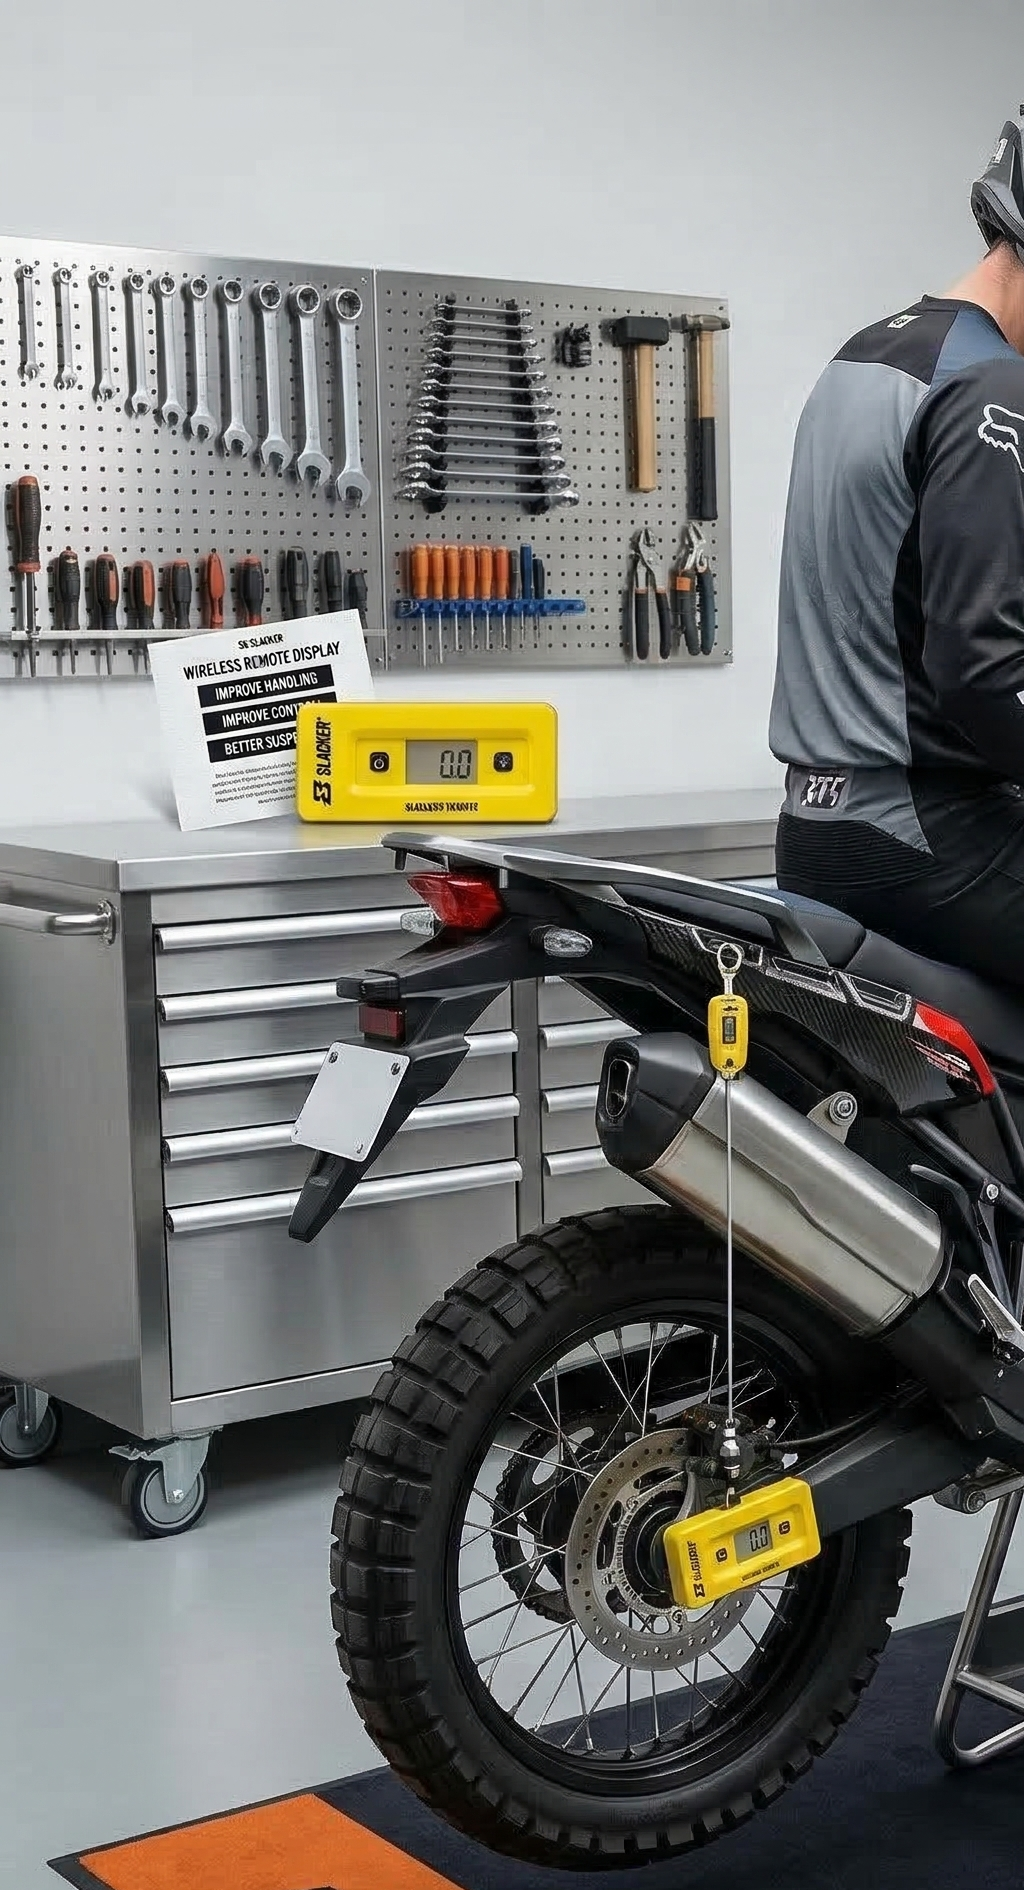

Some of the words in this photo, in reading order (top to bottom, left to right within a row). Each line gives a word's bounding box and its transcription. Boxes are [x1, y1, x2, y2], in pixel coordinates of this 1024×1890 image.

[183, 658, 242, 681] WIRELESS
[244, 649, 291, 670] REMOTE
[293, 641, 340, 663] DISPLAY
[215, 680, 264, 701] IMPROVE
[264, 671, 318, 693] HANDLING
[222, 708, 271, 728] IMPROVE
[224, 736, 263, 755] BETTER
[316, 721, 332, 776] SLACKER
[439, 749, 472, 779] 0.0
